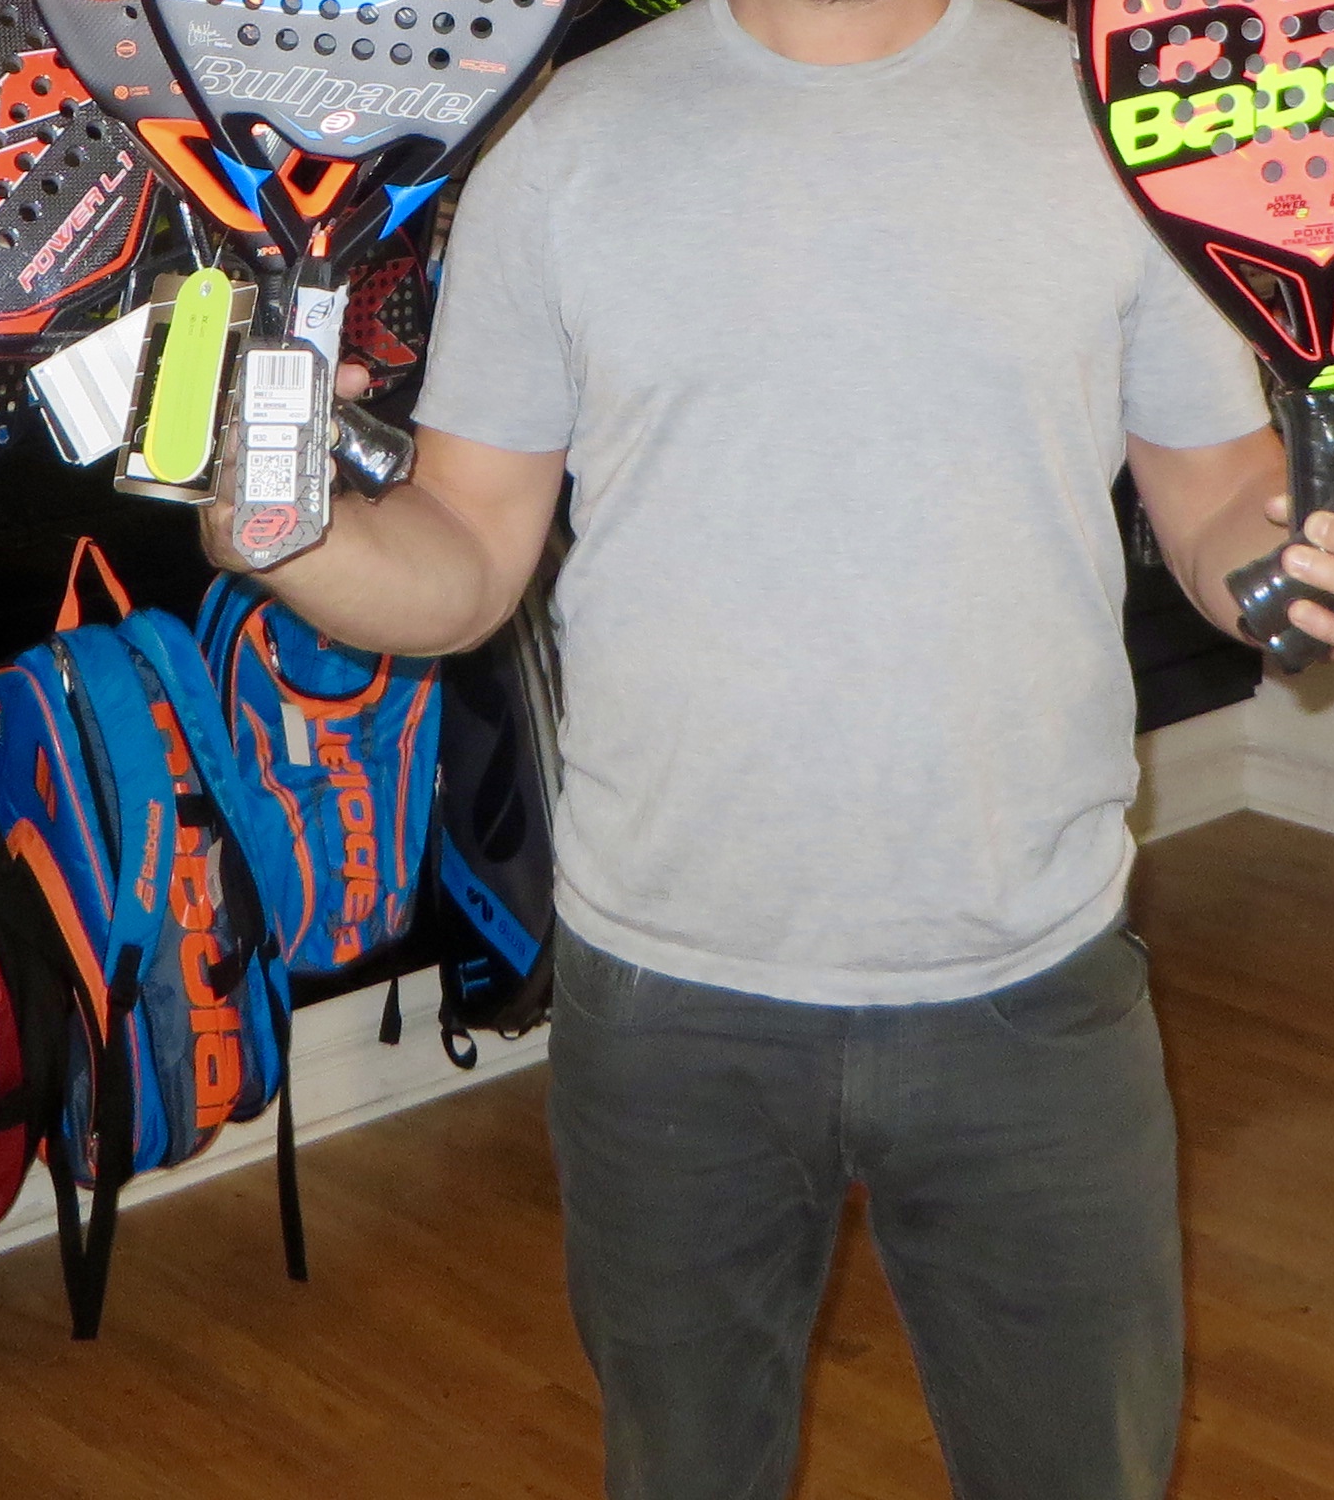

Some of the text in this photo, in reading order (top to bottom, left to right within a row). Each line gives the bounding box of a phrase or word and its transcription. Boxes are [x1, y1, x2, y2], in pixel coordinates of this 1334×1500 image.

[193, 55, 496, 125] Bullpadel
[1274, 193, 1302, 203] ULTRA
[1266, 199, 1307, 212] POWER
[1272, 207, 1298, 219] CORE
[17, 185, 105, 294] POWER
